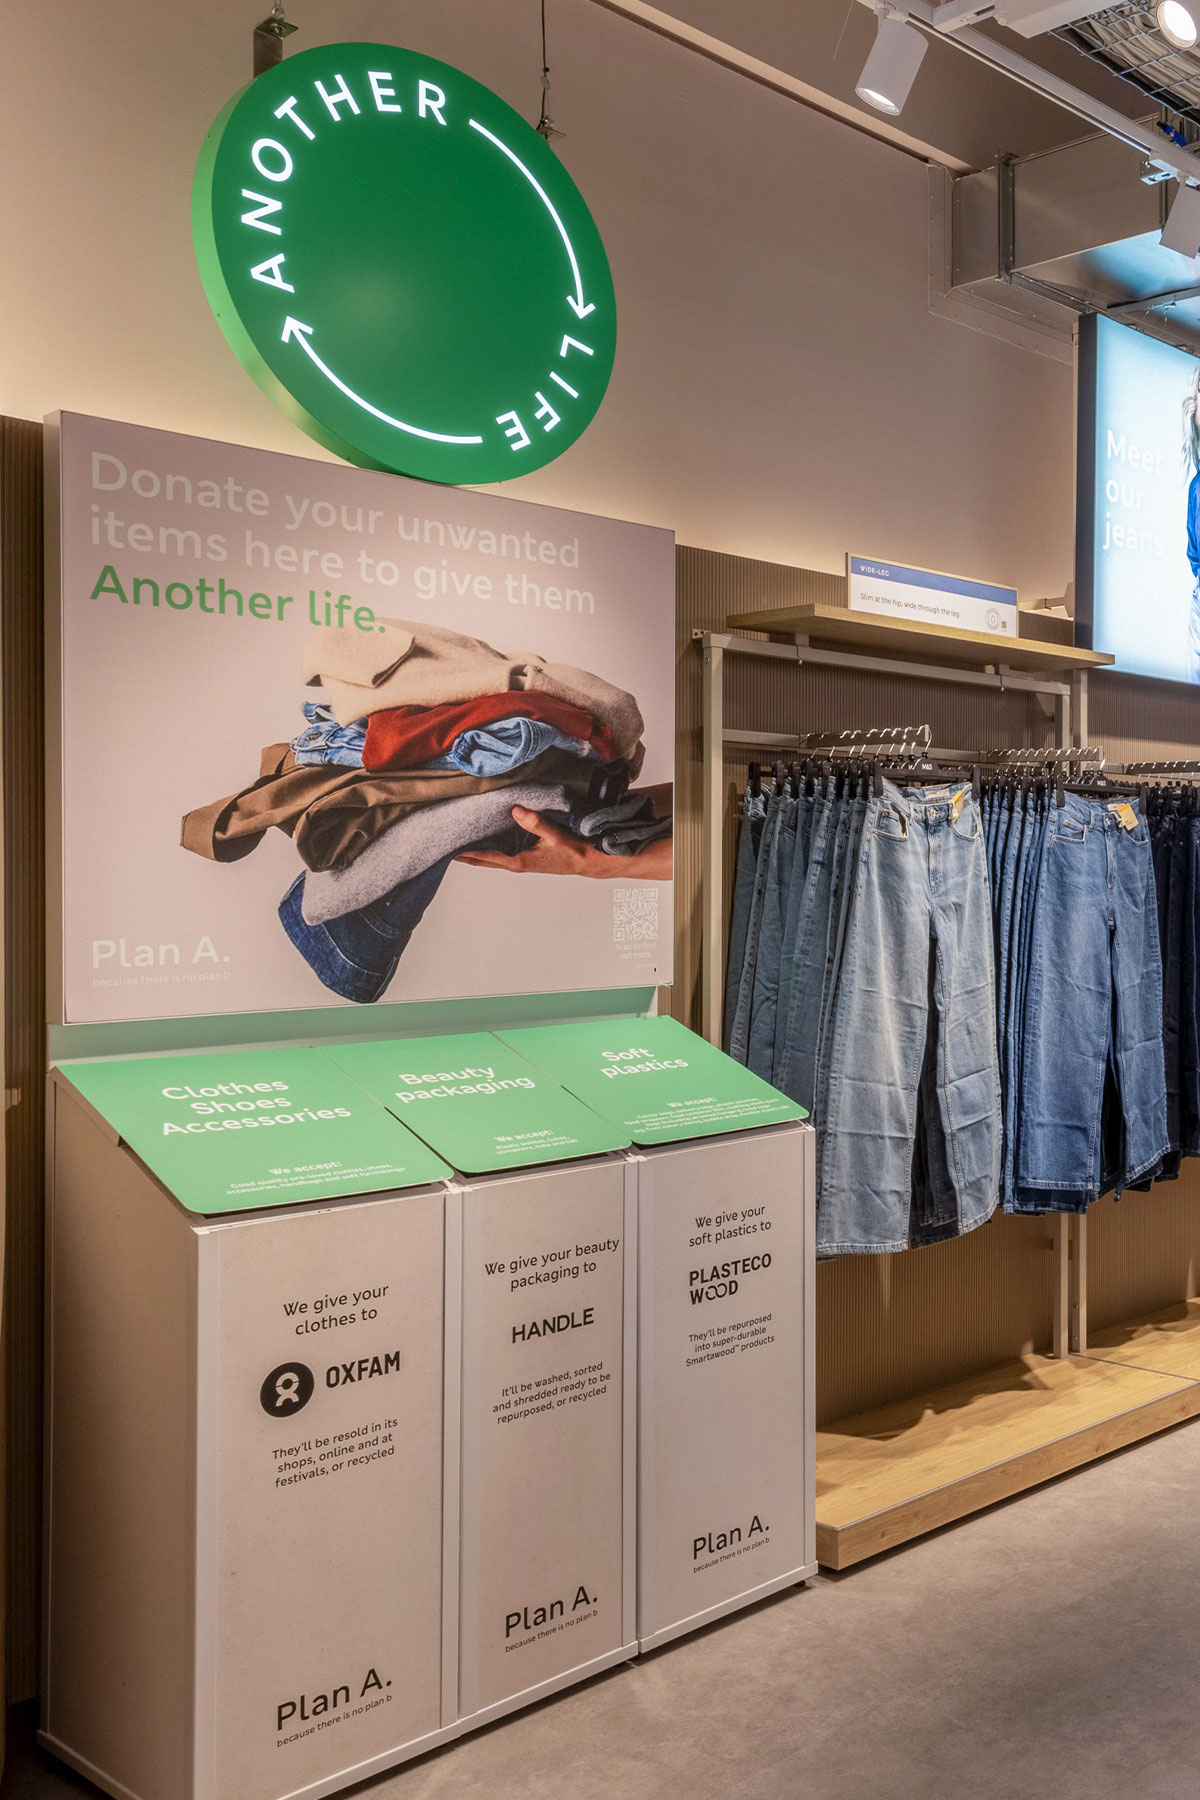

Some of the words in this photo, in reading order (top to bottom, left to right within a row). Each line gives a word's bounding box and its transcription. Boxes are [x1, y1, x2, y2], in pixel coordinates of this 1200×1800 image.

[241, 71, 447, 294] ANOTHER
[495, 334, 595, 452] LIFE
[1106, 429, 1166, 478] Meet
[91, 451, 270, 517] Donate
[284, 494, 384, 534] your
[398, 513, 579, 569] unwanted
[1105, 479, 1145, 511] our
[1102, 511, 1166, 558] jeans
[90, 503, 228, 562] items
[245, 529, 344, 579] here
[357, 550, 400, 587] to
[414, 559, 493, 601] give
[504, 572, 596, 615] them
[859, 565, 890, 577] WIDE-LEG
[89, 564, 294, 621] Another
[308, 589, 386, 634] life.
[860, 593, 874, 602] Slim
[881, 596, 892, 605] the
[892, 599, 904, 608] hip,
[903, 600, 917, 610] wide
[917, 603, 941, 616] through
[940, 607, 951, 616] the
[950, 609, 960, 619] leg
[921, 763, 933, 771] M&S
[92, 937, 181, 969] Plan
[191, 935, 231, 964] A.
[92, 976, 139, 988] because
[141, 974, 170, 985] there
[171, 973, 181, 984] is
[183, 974, 197, 983] no
[198, 970, 222, 984] plan
[223, 969, 231, 980] b
[600, 1059, 689, 1079] plastics
[601, 1047, 655, 1062] Soft
[161, 1081, 289, 1100] Clothes
[394, 1076, 536, 1104] packaging
[398, 1066, 495, 1086] Beauty
[163, 1107, 352, 1136] Accessories
[190, 1097, 292, 1115] Shoes
[514, 1130, 554, 1140] accept:
[268, 1167, 291, 1175] We
[294, 1161, 343, 1173] accept:
[689, 1232, 712, 1247] soft
[715, 1223, 758, 1244] plastics
[760, 1220, 772, 1232] to
[695, 1216, 712, 1229] We
[715, 1211, 738, 1227] give
[740, 1206, 766, 1222] your
[484, 1261, 506, 1275] We
[509, 1256, 538, 1274] give
[541, 1248, 572, 1268] your
[575, 1239, 620, 1257] beauty
[689, 1253, 772, 1287] PLASTECO
[510, 1265, 580, 1292] packaging
[583, 1261, 597, 1273] to
[689, 1280, 739, 1305] WOOD
[283, 1301, 308, 1317] We
[313, 1294, 348, 1314] give
[352, 1285, 389, 1306] your
[295, 1313, 357, 1335] clothes
[361, 1308, 378, 1321] to
[511, 1307, 595, 1344] HANDLE
[688, 1329, 715, 1343] They'll
[716, 1326, 727, 1335] be
[728, 1312, 772, 1332] repurposed
[694, 1341, 711, 1353] into
[712, 1326, 767, 1348] super-durable
[740, 1335, 775, 1352] products
[325, 1350, 401, 1389] OXFAM
[501, 1386, 519, 1398] It'll
[520, 1383, 533, 1393] be
[534, 1371, 572, 1388] washed,
[573, 1361, 603, 1378] sorted
[492, 1400, 511, 1413] and
[513, 1387, 558, 1407] shredded
[560, 1379, 586, 1394] ready
[588, 1376, 598, 1385] to
[600, 1372, 611, 1382] be
[497, 1400, 555, 1425] repurposed,
[556, 1397, 567, 1407] or
[568, 1385, 607, 1404] recycled
[272, 1440, 312, 1460] They'll
[315, 1437, 330, 1449] be
[333, 1425, 369, 1443] resold
[371, 1422, 382, 1433] in
[384, 1419, 398, 1429] its
[277, 1456, 316, 1473] shops,
[319, 1445, 355, 1461] online
[357, 1436, 379, 1451] and
[381, 1433, 393, 1442] at
[274, 1467, 329, 1488] festivals,
[331, 1462, 344, 1472] or
[347, 1445, 395, 1468] recycled
[693, 1527, 742, 1560] Plan
[747, 1514, 770, 1538] A.
[693, 1557, 719, 1573] because
[719, 1551, 736, 1563] there
[736, 1548, 742, 1556] is
[742, 1545, 751, 1553] no
[751, 1539, 765, 1551] plan
[505, 1599, 564, 1639] Plan
[571, 1585, 598, 1612] A.
[504, 1635, 536, 1653] because
[537, 1626, 557, 1640] there
[557, 1623, 564, 1631] is
[565, 1620, 575, 1628] no
[575, 1613, 592, 1625] plan
[592, 1609, 598, 1617] b
[277, 1685, 350, 1731] Plan
[359, 1667, 392, 1698] A.
[276, 1726, 316, 1748] because
[317, 1715, 341, 1731] there
[342, 1711, 350, 1720] is
[352, 1706, 364, 1717] no
[365, 1697, 385, 1713] plan
[386, 1694, 392, 1703] b
